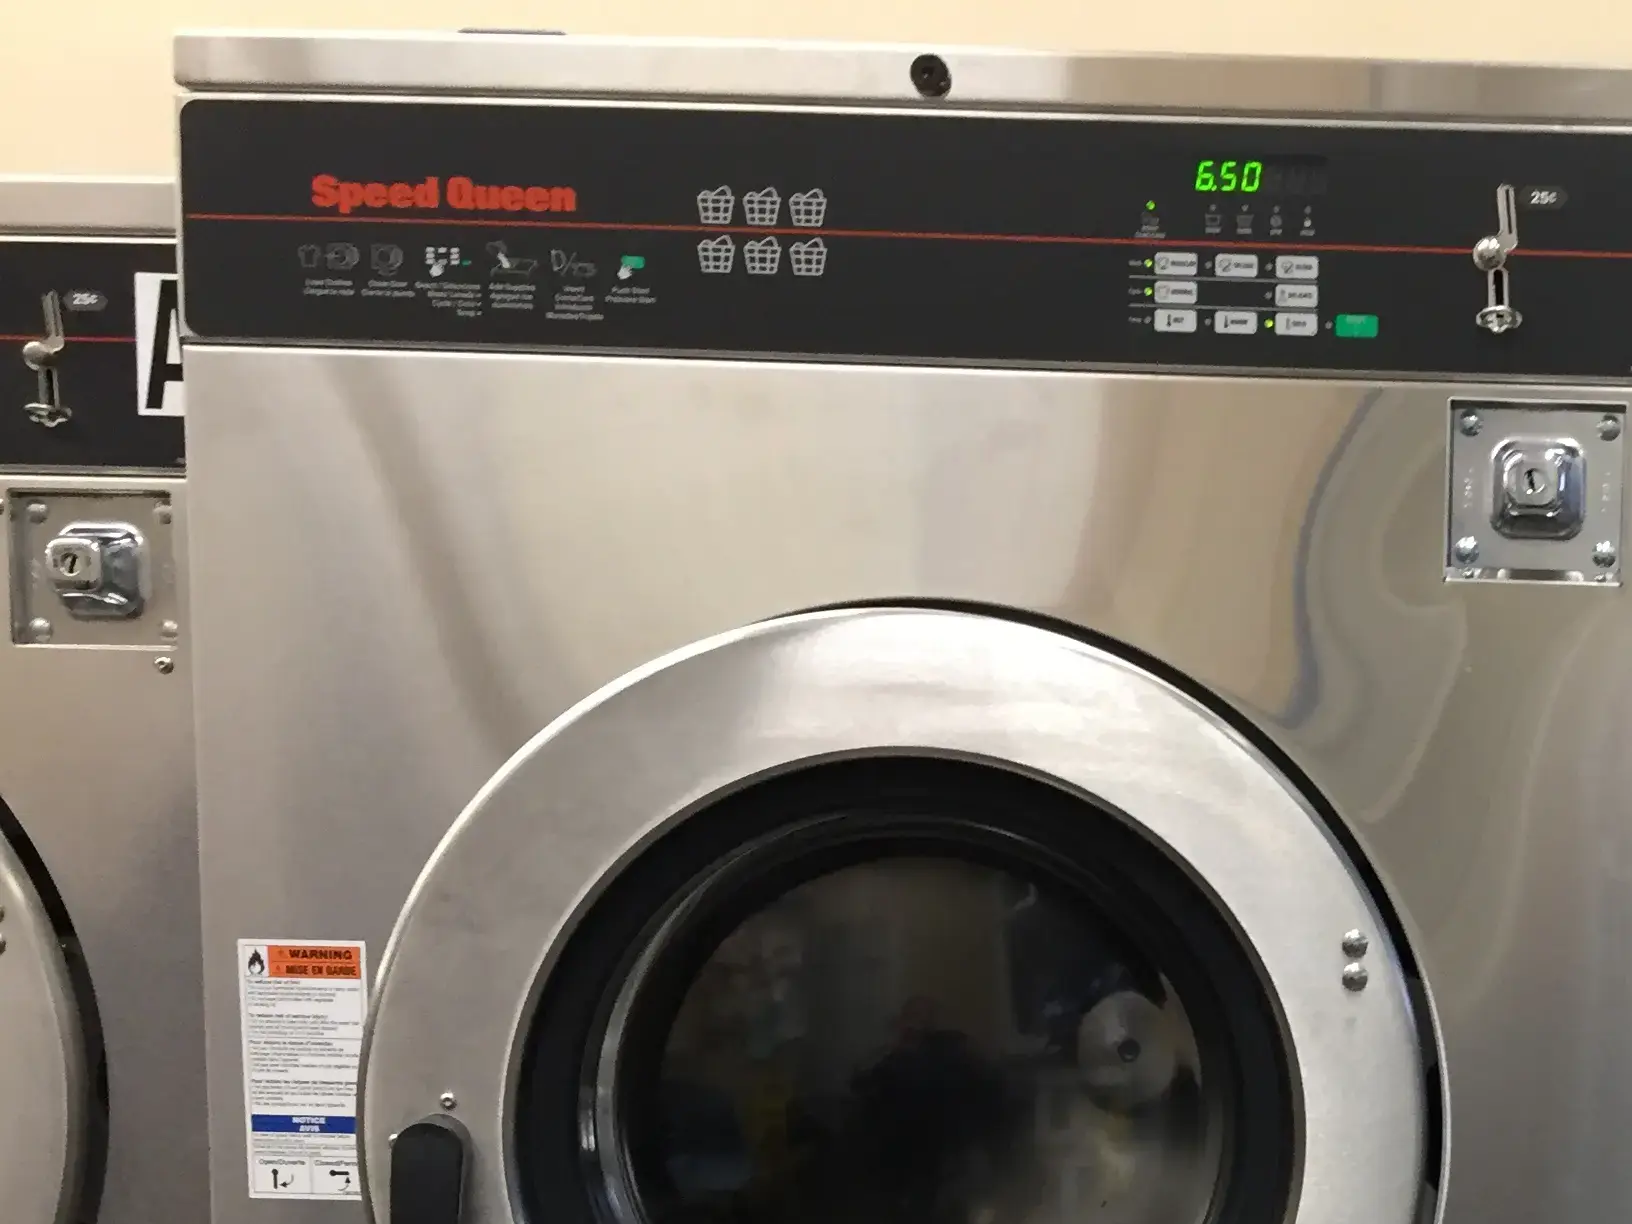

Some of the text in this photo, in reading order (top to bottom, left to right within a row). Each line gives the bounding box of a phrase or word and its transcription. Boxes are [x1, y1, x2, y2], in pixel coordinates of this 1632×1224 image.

[1195, 160, 1262, 192] 6.50
[312, 174, 576, 214] Speed Queen
[289, 949, 352, 960] WARNING
[292, 1116, 326, 1125] NOTICE
